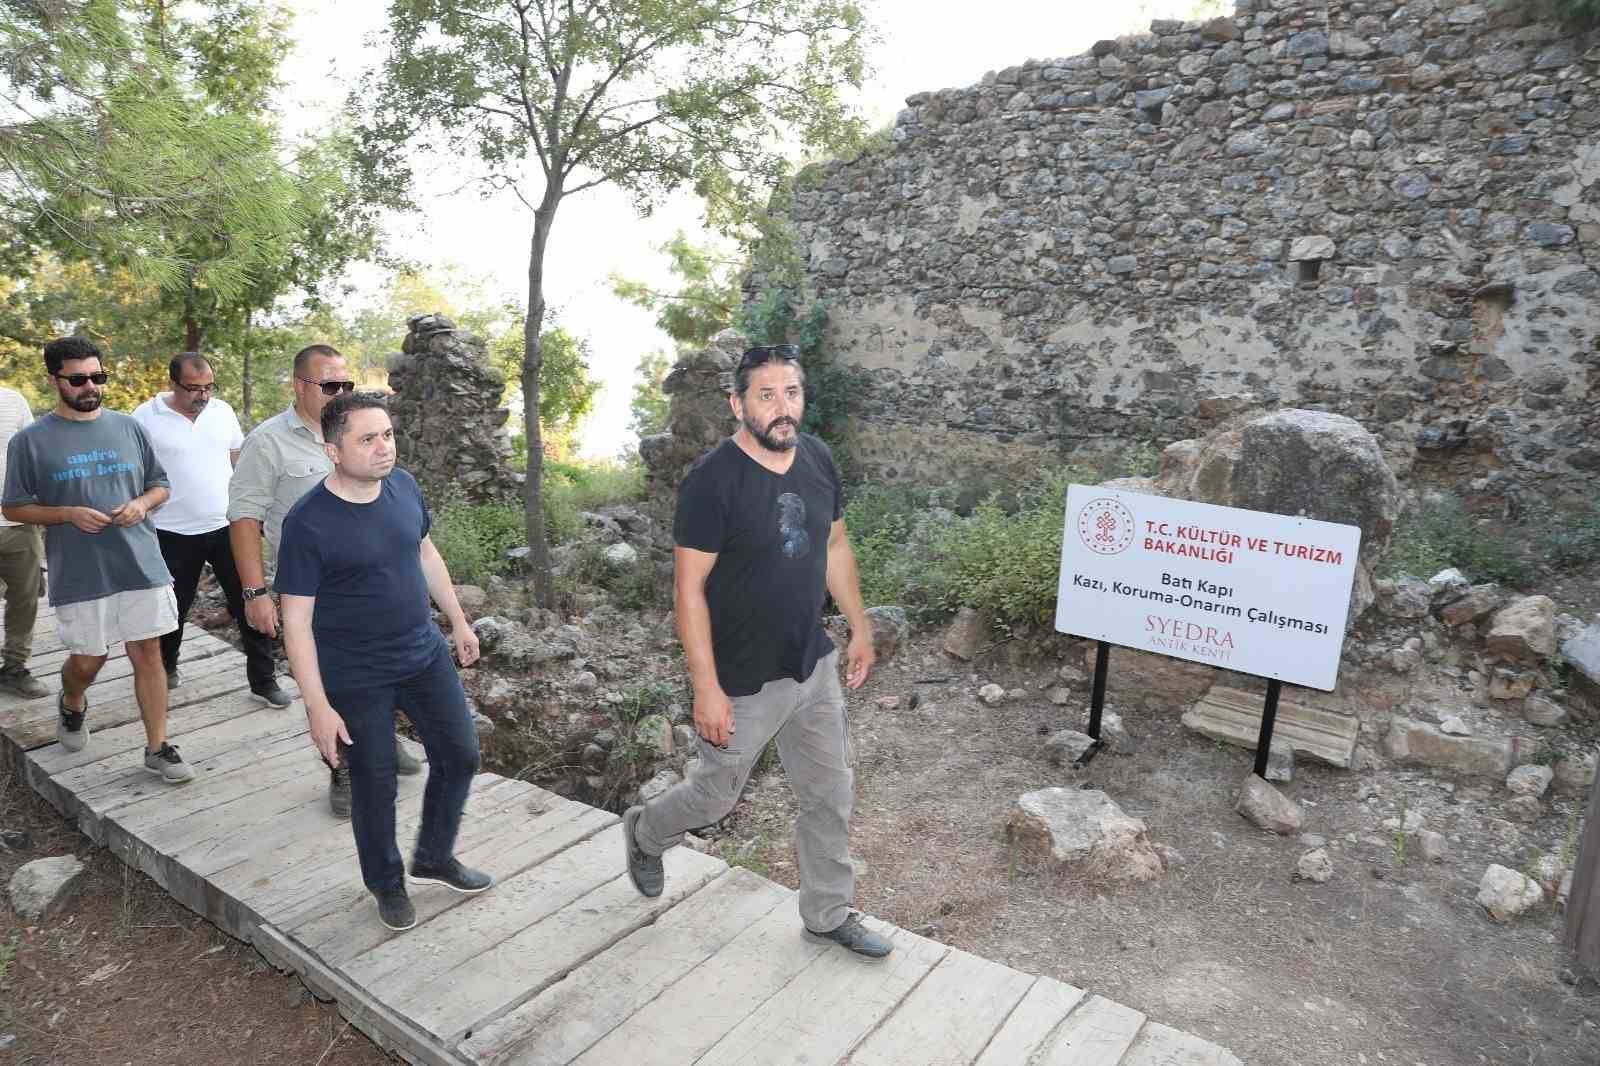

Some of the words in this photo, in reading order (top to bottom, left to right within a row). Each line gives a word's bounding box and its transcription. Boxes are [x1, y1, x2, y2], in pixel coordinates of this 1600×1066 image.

[1144, 538, 1234, 564] BAKANLIĞI
[1146, 521, 1173, 536] T.C.
[1177, 526, 1241, 548] KÜLTÜR
[1247, 537, 1268, 553] VE
[1274, 541, 1343, 565] TURİZM
[1161, 572, 1193, 589] Batı
[1198, 579, 1233, 598] Kapı
[1073, 574, 1108, 593] Kazı,
[1112, 581, 1242, 618] Koruma-Onarım
[1247, 607, 1328, 634] Çalışması
[1145, 614, 1234, 649] SYEDRA
